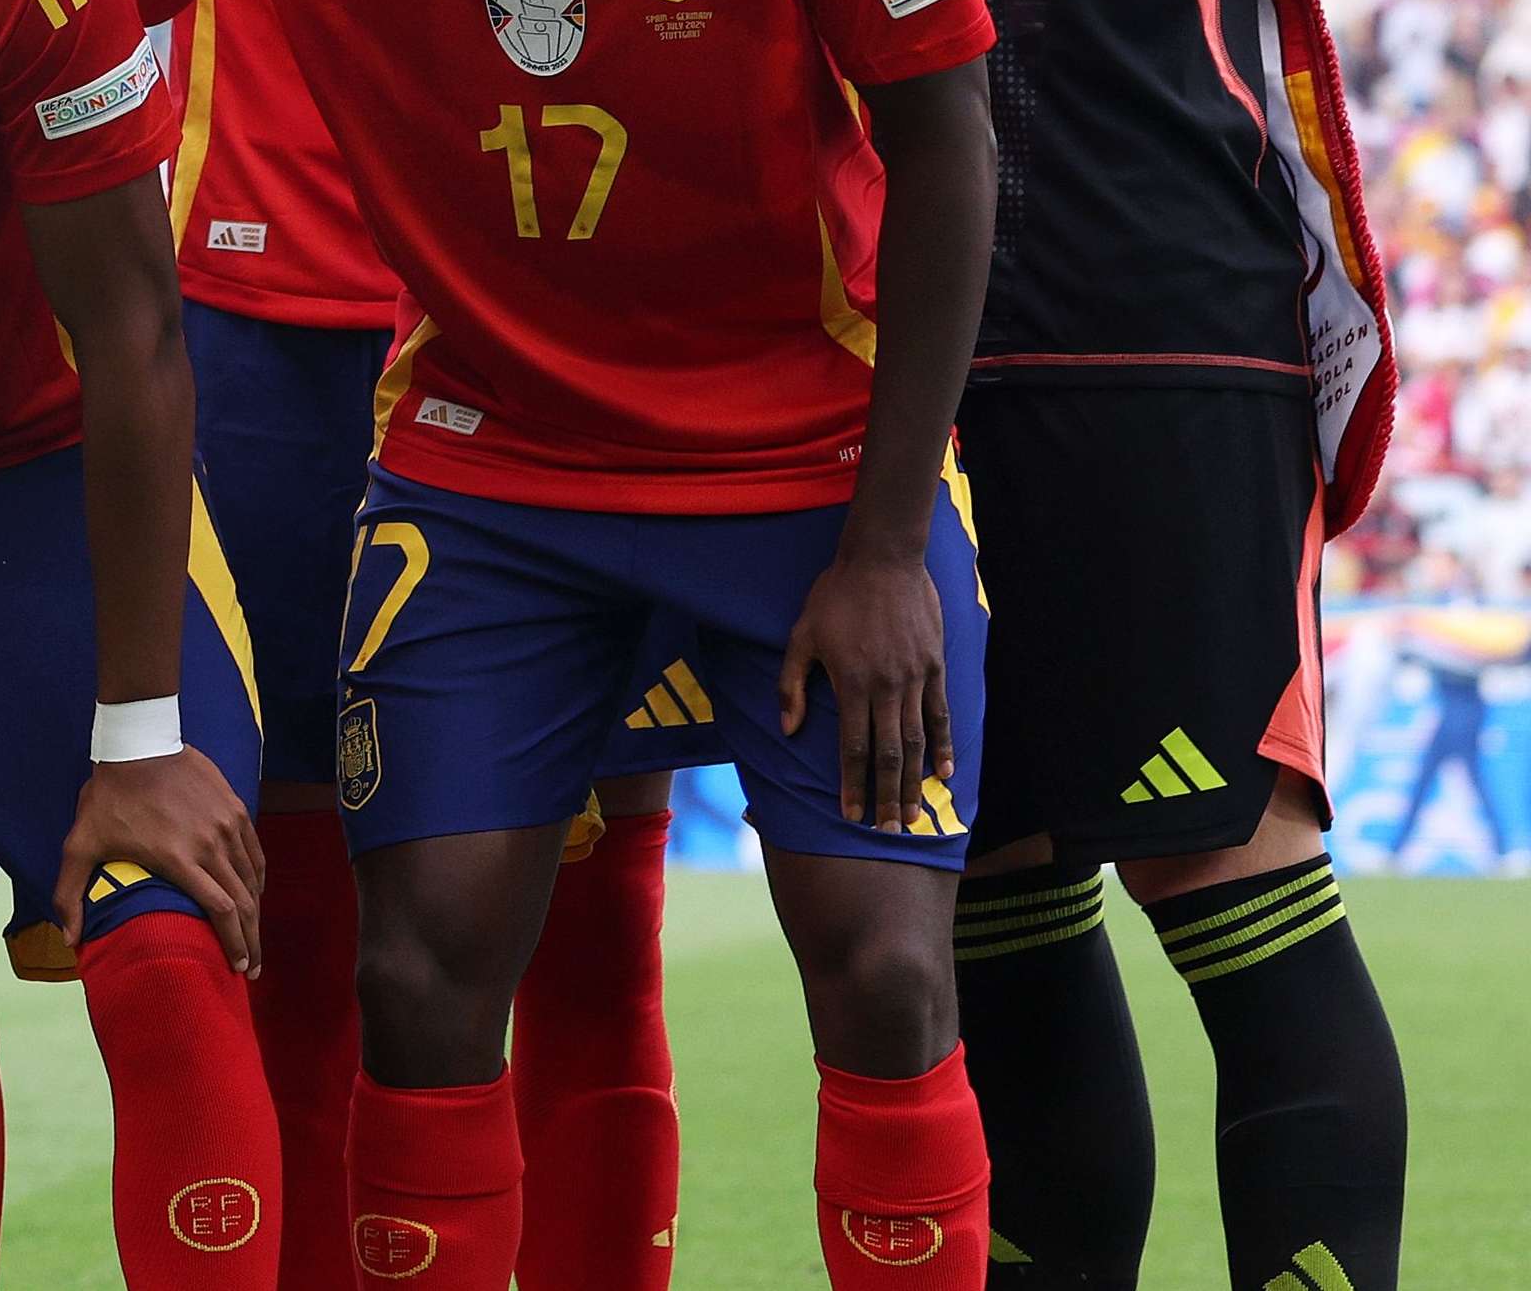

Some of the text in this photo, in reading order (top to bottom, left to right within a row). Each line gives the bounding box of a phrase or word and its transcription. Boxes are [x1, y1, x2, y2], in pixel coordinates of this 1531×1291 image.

[41, 96, 74, 113] UEFA
[42, 50, 155, 126] FOUNDATION
[479, 103, 629, 240] 17
[1309, 319, 1332, 348] EAL
[1317, 323, 1368, 365] ACIÓN
[1318, 382, 1352, 416] TBOL
